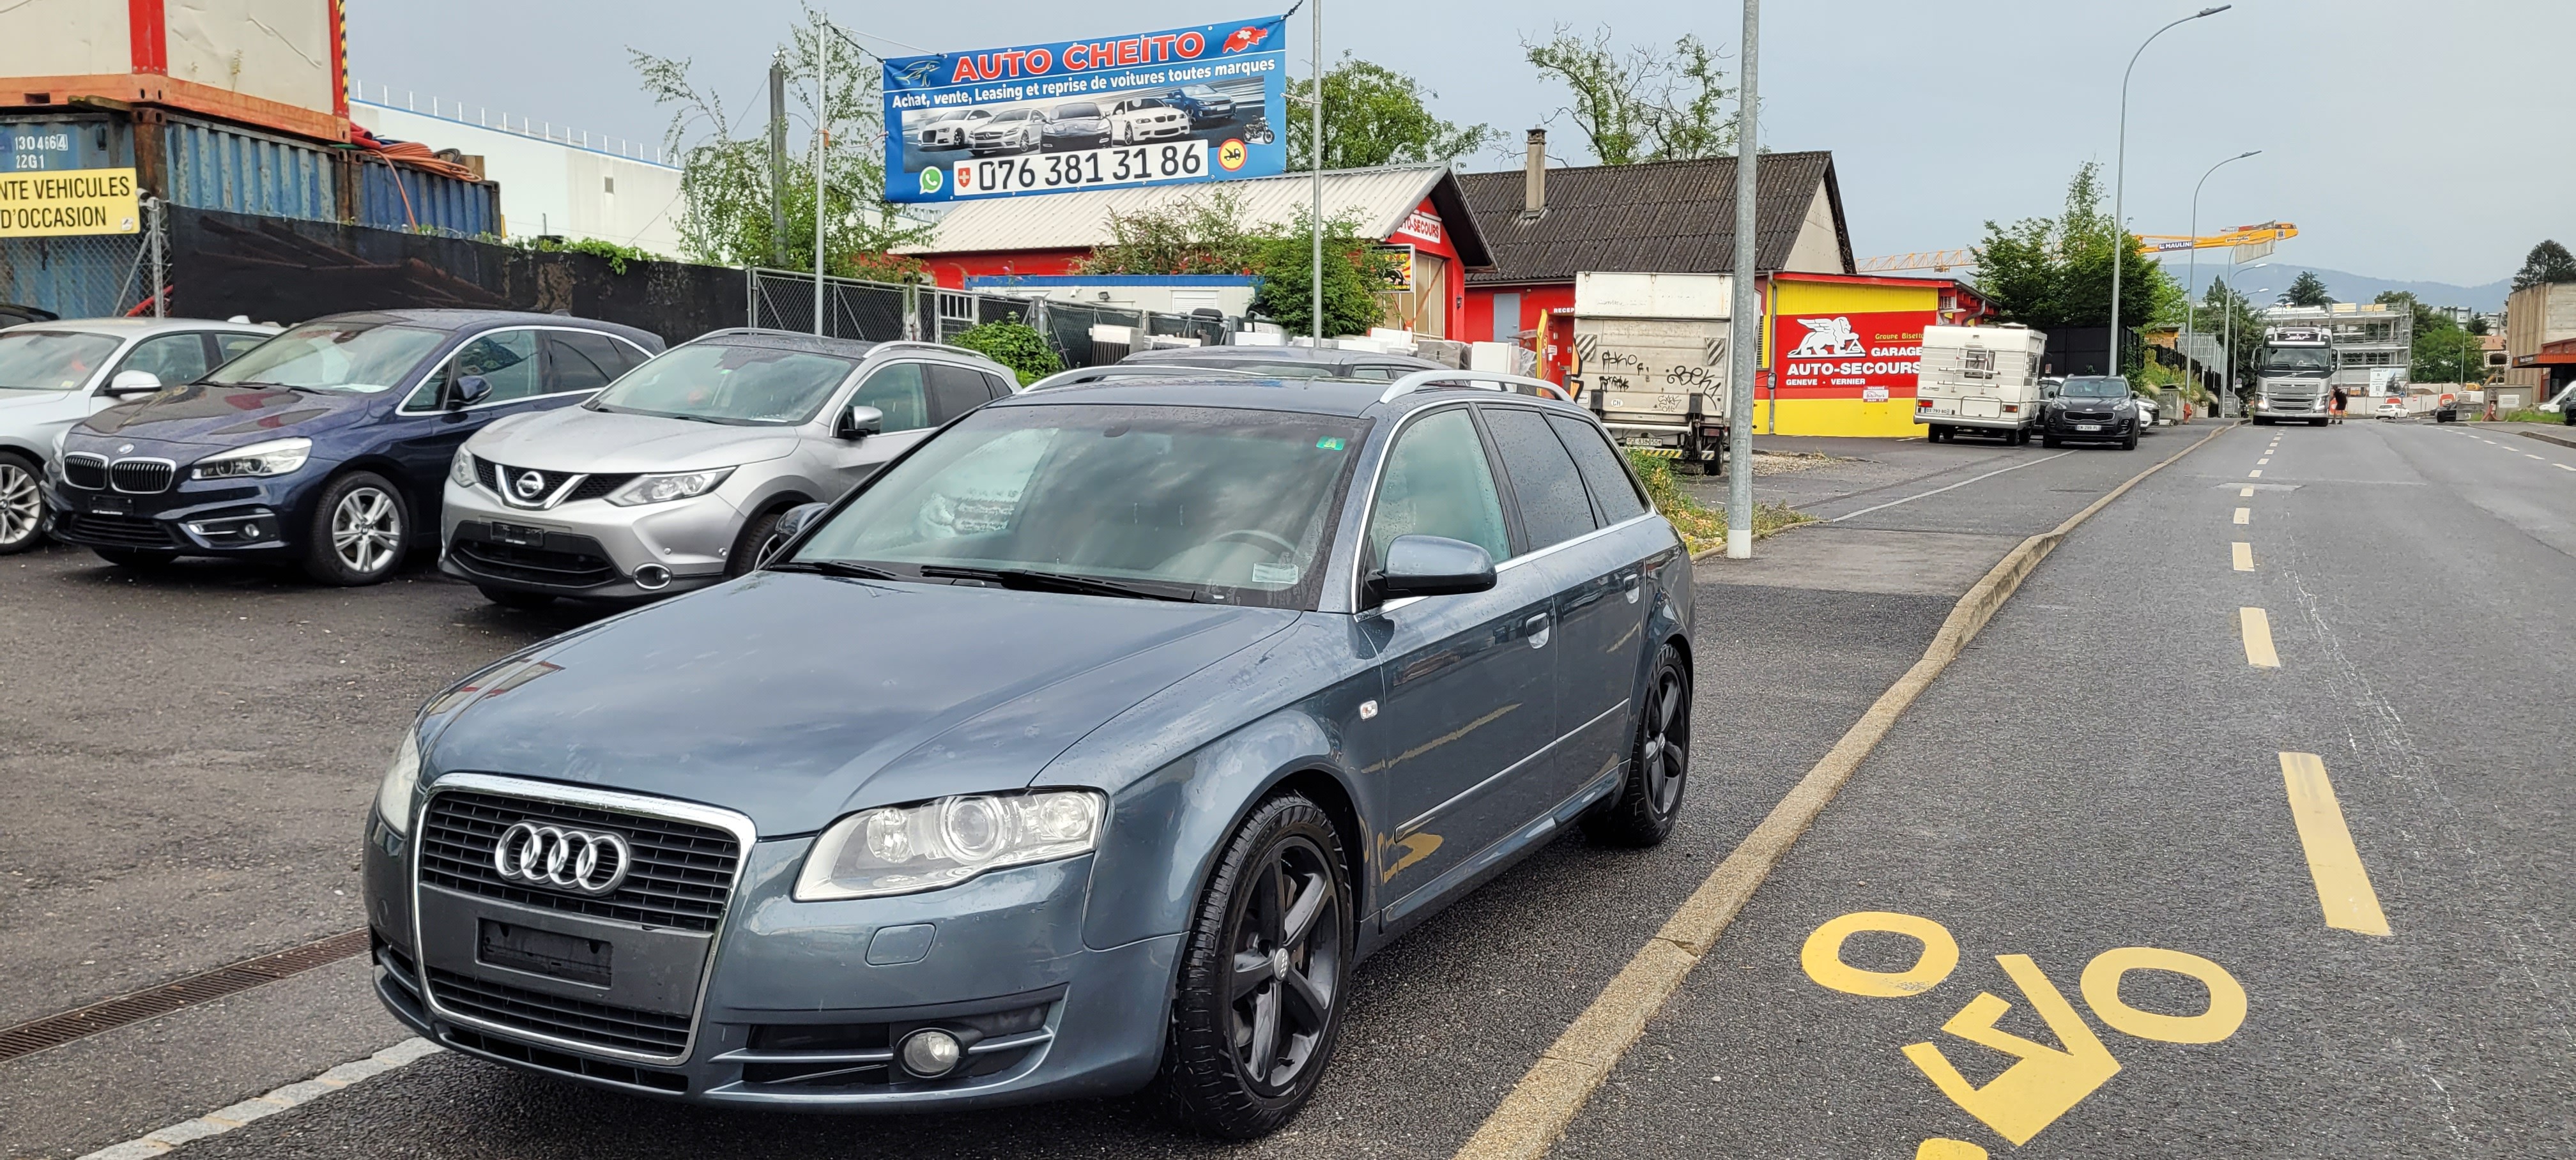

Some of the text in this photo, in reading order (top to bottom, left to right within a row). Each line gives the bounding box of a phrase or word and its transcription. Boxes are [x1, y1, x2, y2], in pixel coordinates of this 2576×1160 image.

[951, 31, 1206, 84] AUTO CHEITO
[892, 58, 1275, 109] Achat, vente, Leasing et reprise de voitures toutes marques
[16, 153, 45, 169] 22G1
[978, 142, 1201, 192] 076 381 31 86
[34, 176, 130, 200] VEHICULES
[1, 206, 107, 229] D'OCCASION
[1871, 347, 1922, 356] GARAGE
[1787, 362, 1920, 375] AUTO-SECOURS
